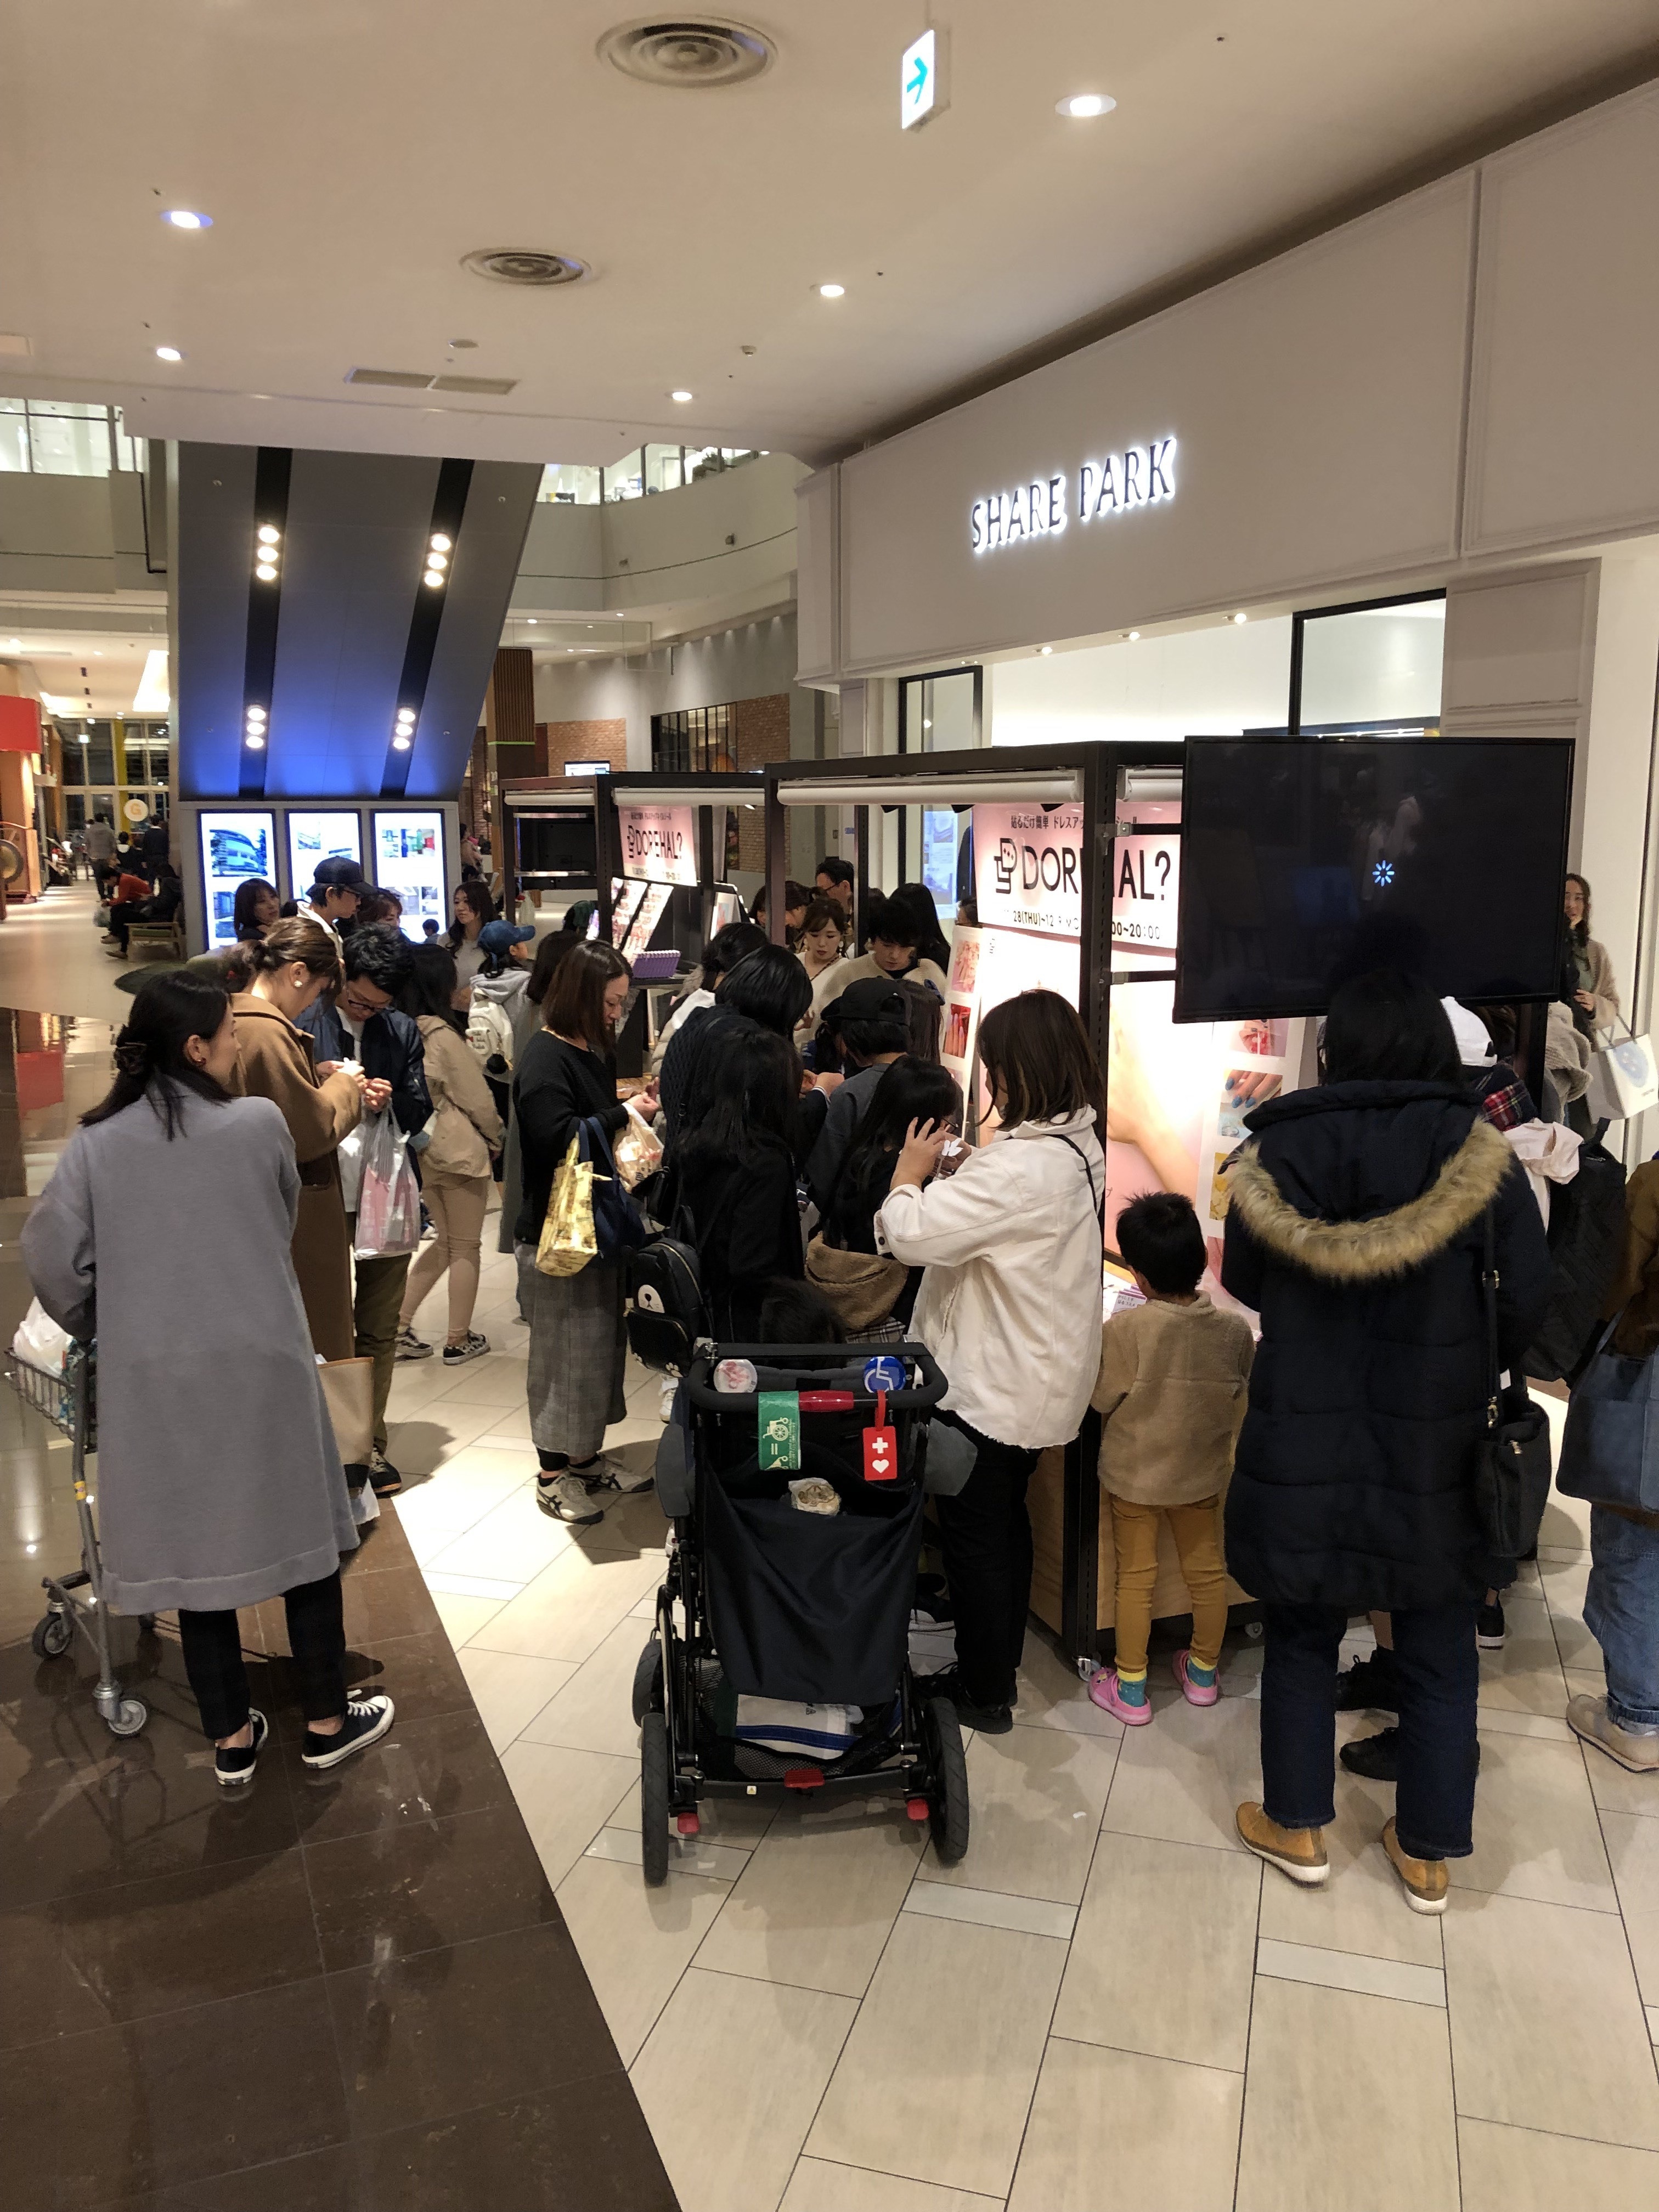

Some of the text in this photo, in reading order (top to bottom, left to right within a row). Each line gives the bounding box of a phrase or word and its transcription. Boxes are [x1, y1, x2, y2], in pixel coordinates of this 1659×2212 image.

[972, 439, 1174, 550] SHARE PARK
[1011, 815, 1049, 830] 貼るだけ簡単
[635, 830, 682, 860] DOREHAL?
[1022, 845, 1171, 901] DORAL?
